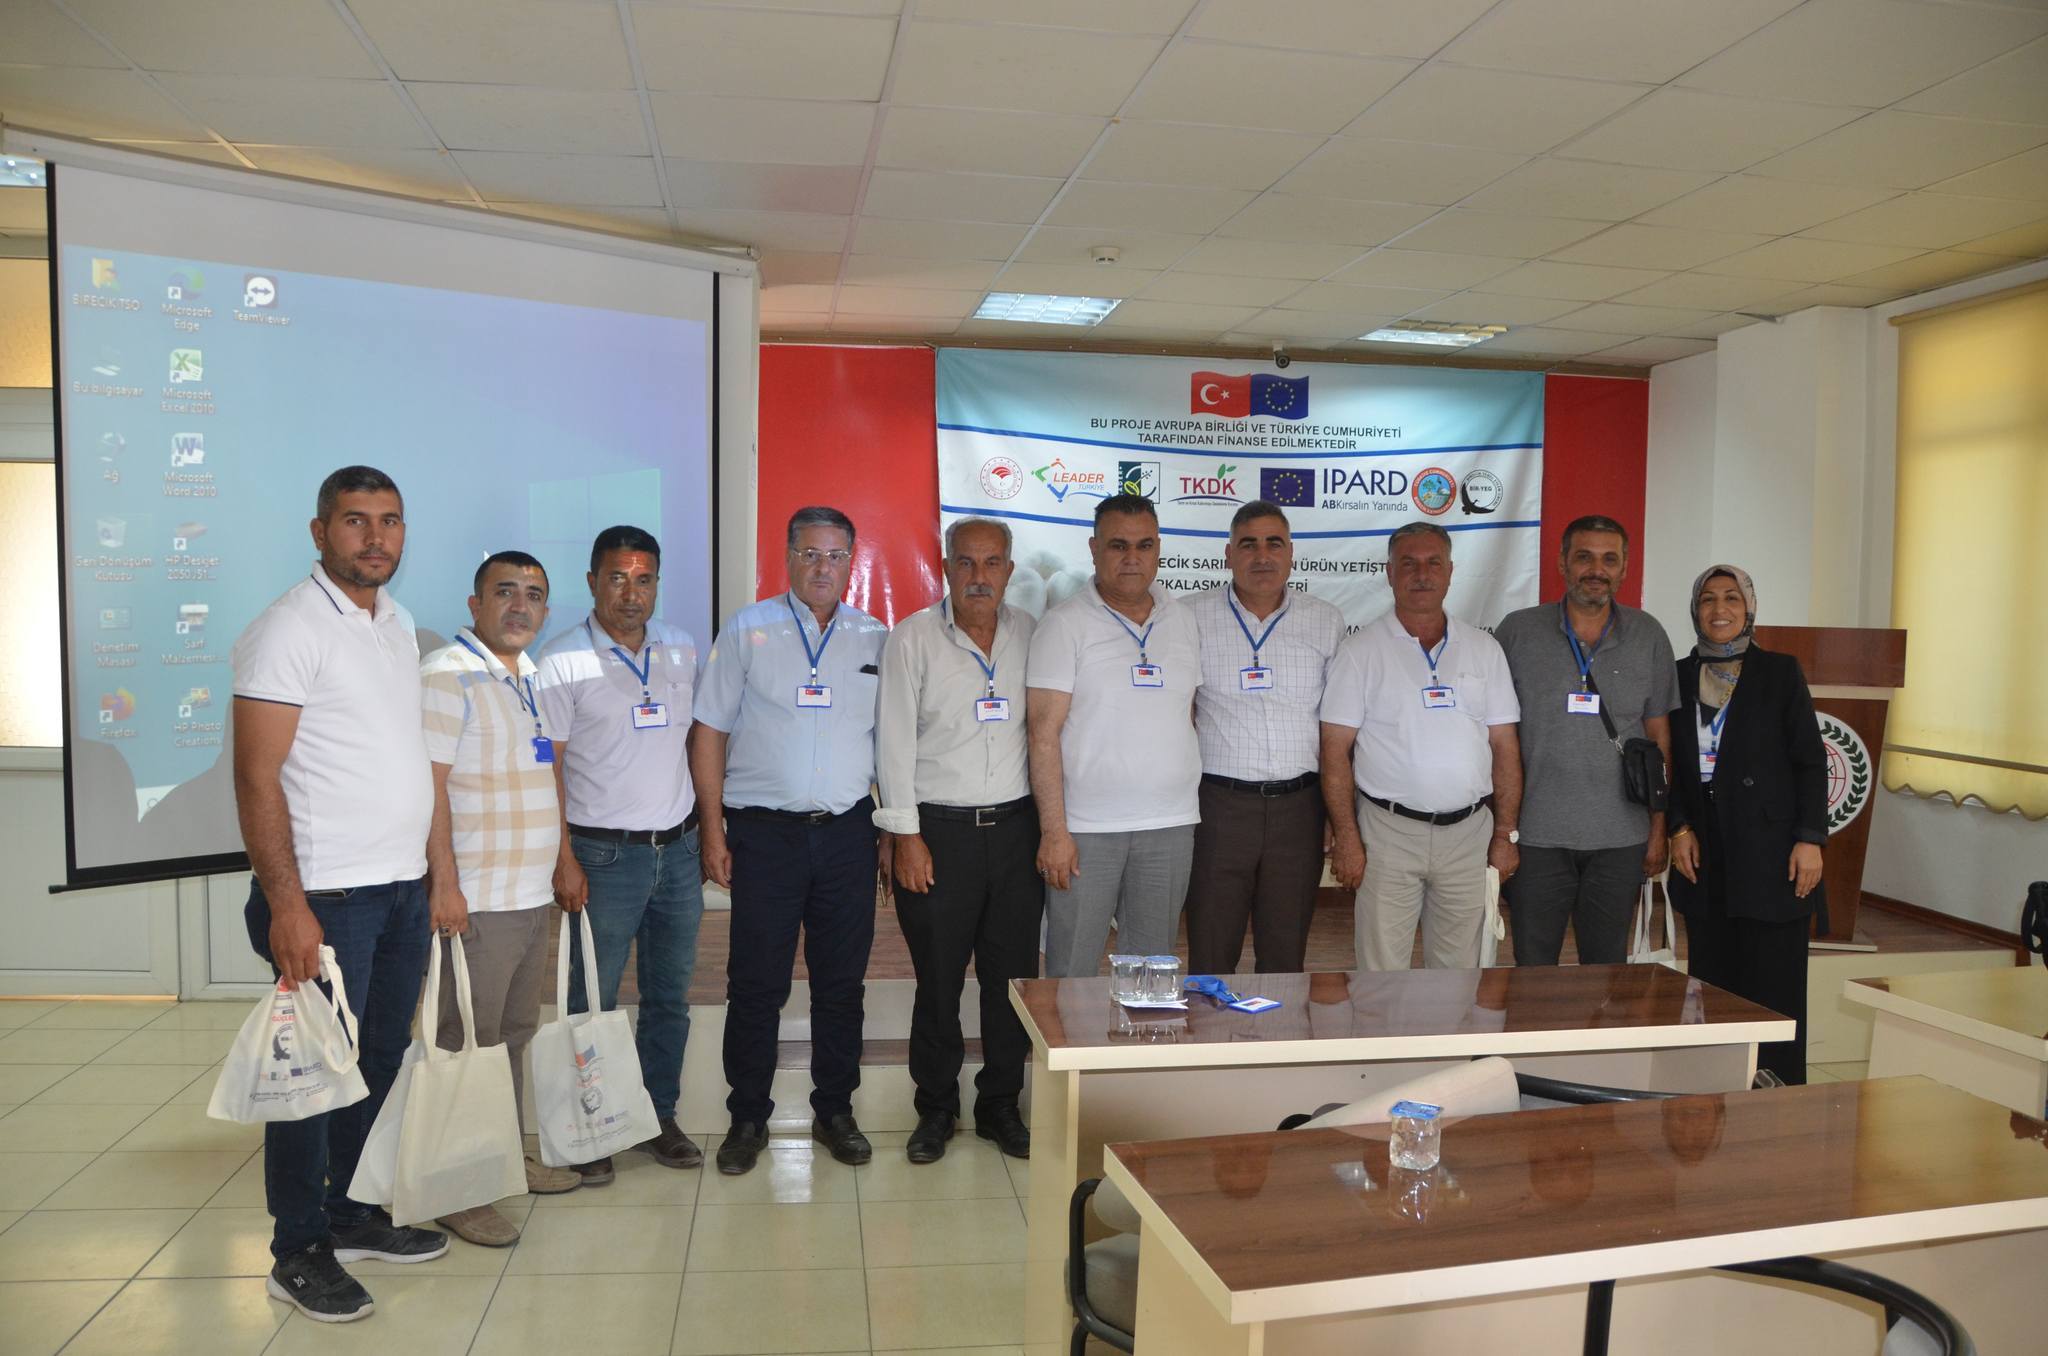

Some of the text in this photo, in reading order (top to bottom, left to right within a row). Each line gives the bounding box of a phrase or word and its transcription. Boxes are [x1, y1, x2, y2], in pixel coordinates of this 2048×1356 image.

[161, 303, 213, 318] Microsoft
[232, 309, 290, 325] TeamViewer
[174, 319, 200, 331] Edge
[72, 382, 89, 393] Bu
[162, 386, 212, 401] Microsoft
[161, 401, 190, 413] Excel
[1090, 418, 1402, 439] BU PROJE AVRUPA BİRLİĞİ VE TÜRKİYE CUMHURİYETİ
[1137, 433, 1357, 450] TARAFINDAN FİNANSE EDİLMEKTEDİR
[164, 471, 214, 483] Microsoft
[1053, 472, 1105, 484] LEADER
[1323, 468, 1408, 496] IPARD
[162, 486, 217, 497] Word 2010
[1179, 477, 1237, 496] TKDK
[1373, 501, 1408, 512] Yanında
[1300, 558, 1338, 572] ÜRÜN
[100, 727, 136, 738] Firefox
[191, 722, 222, 731] Photo
[175, 735, 222, 747] Creations
